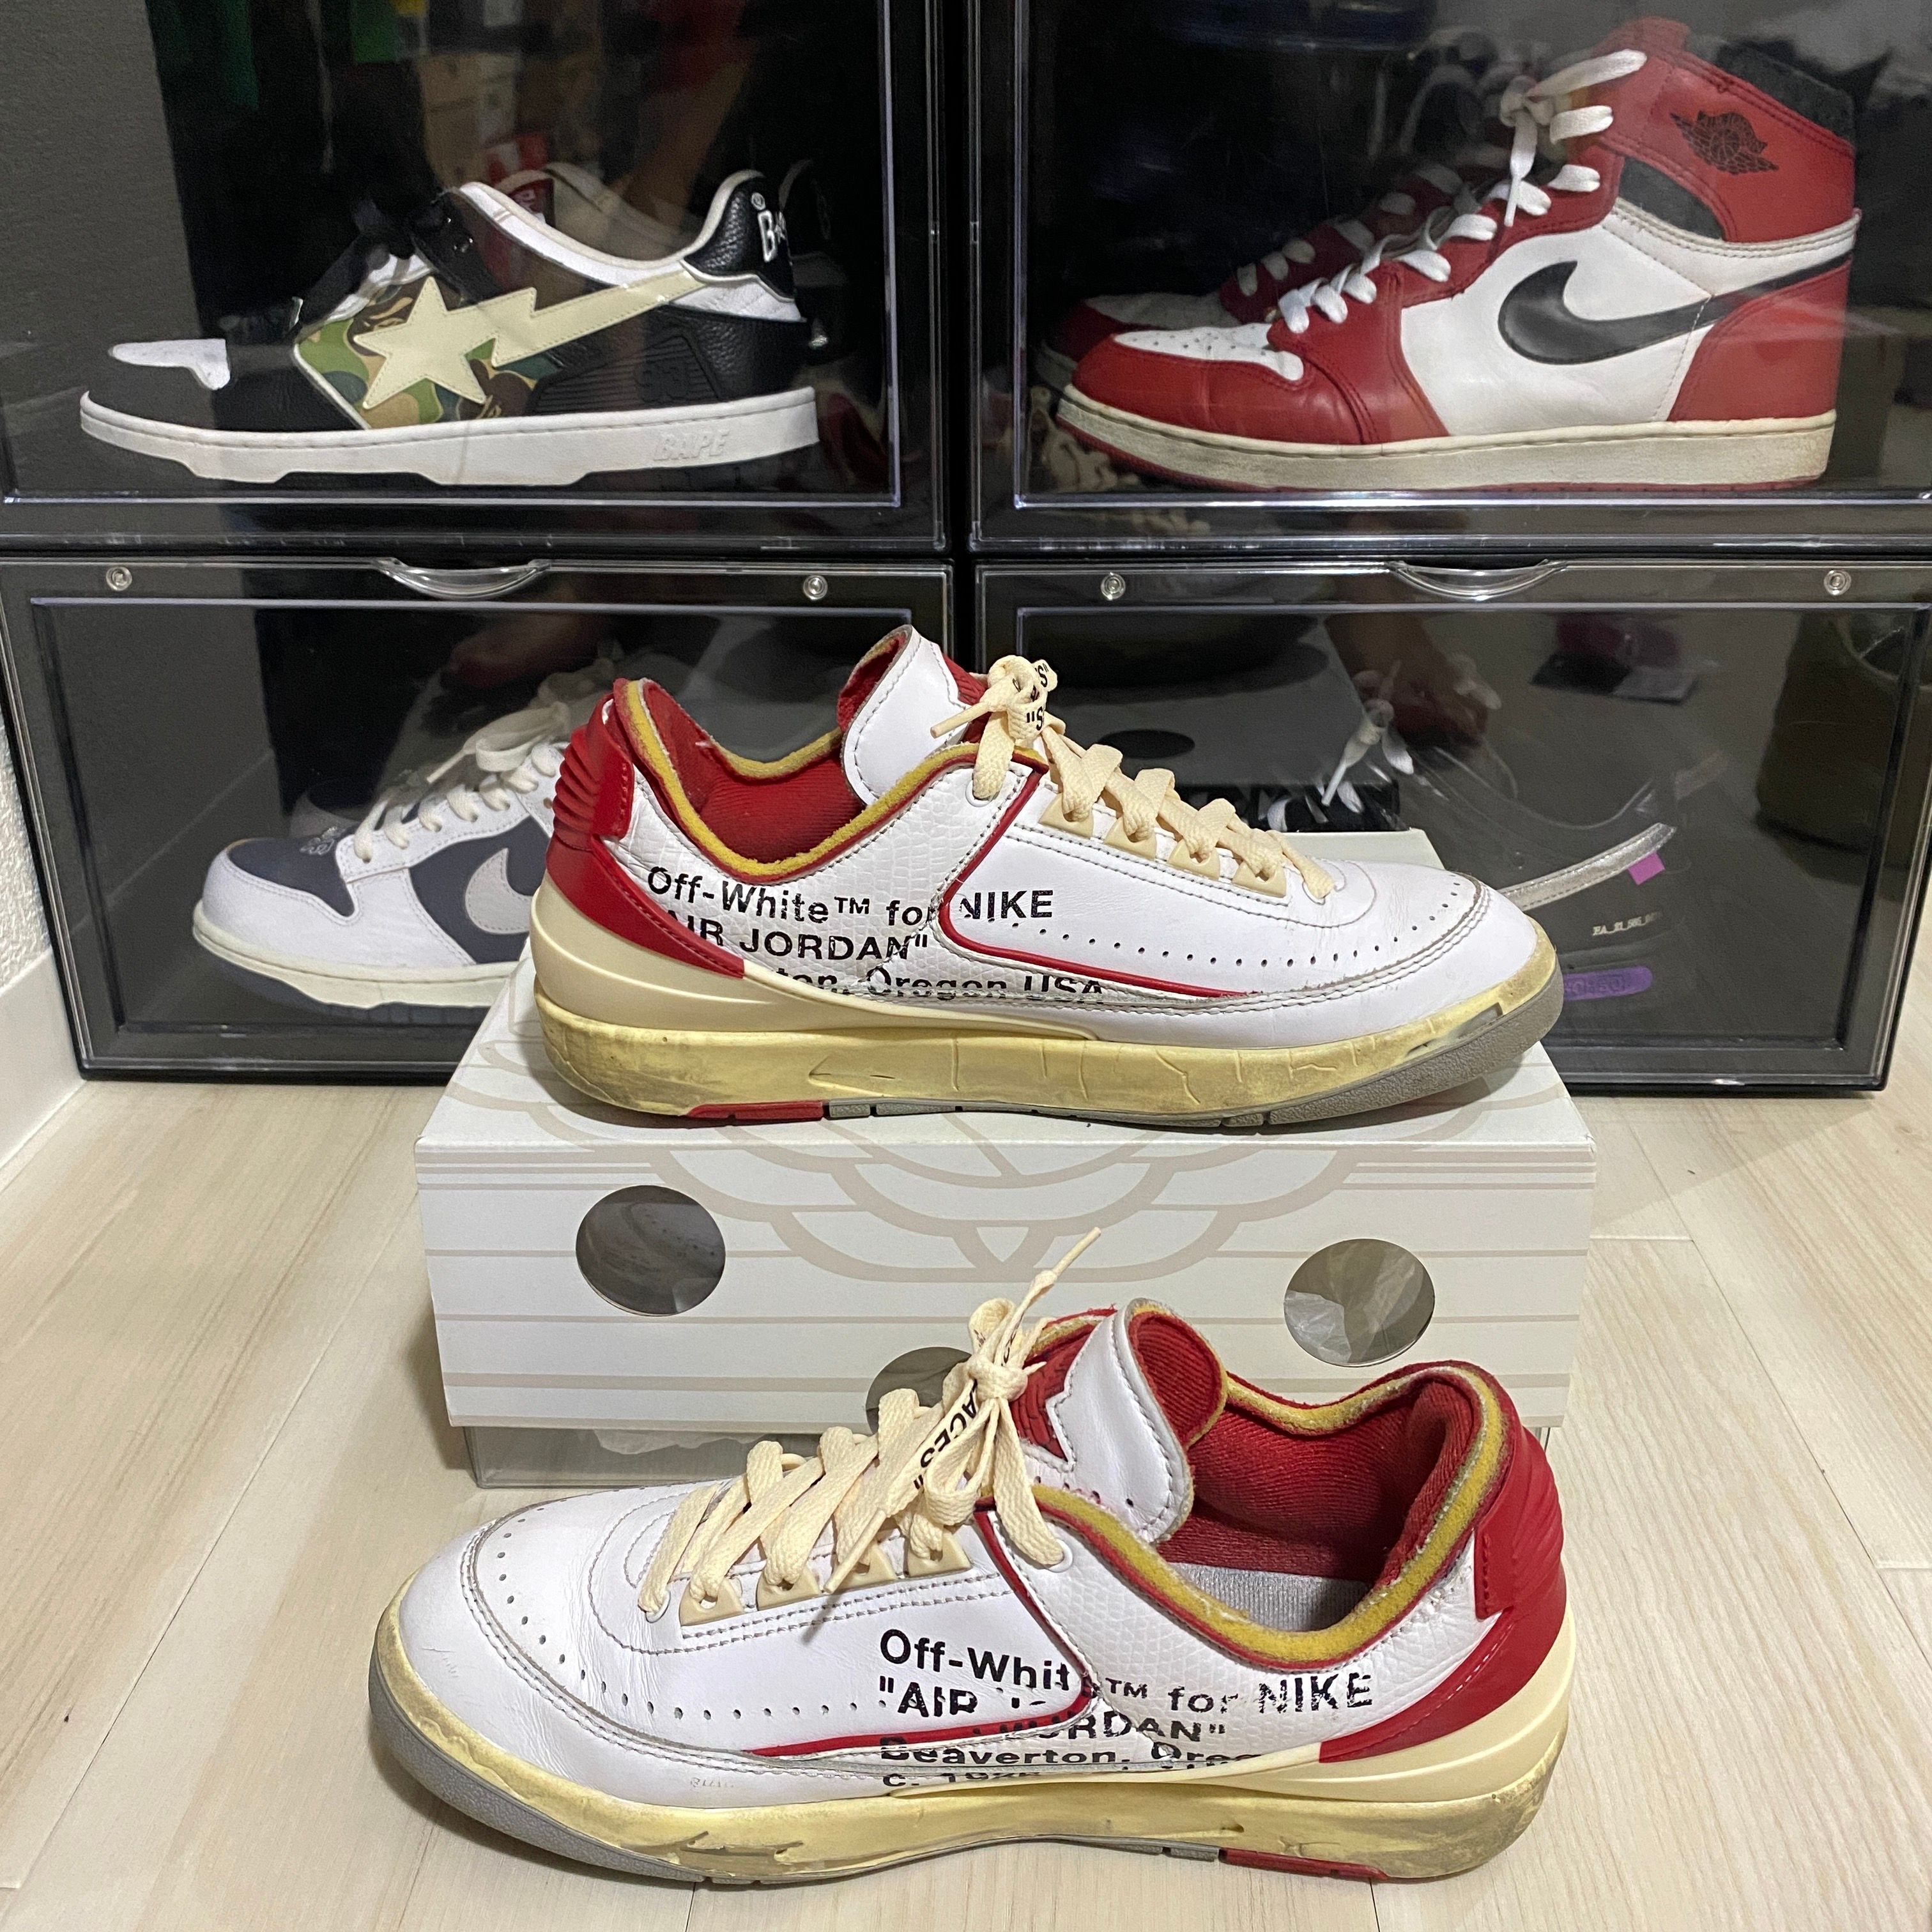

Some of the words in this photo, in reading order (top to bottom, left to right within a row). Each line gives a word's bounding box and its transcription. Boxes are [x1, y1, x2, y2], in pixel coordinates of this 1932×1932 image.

[958, 890, 1053, 919] NIKE
[739, 928, 928, 961] JORDAN"
[1258, 1672, 1373, 1714] NIKE
